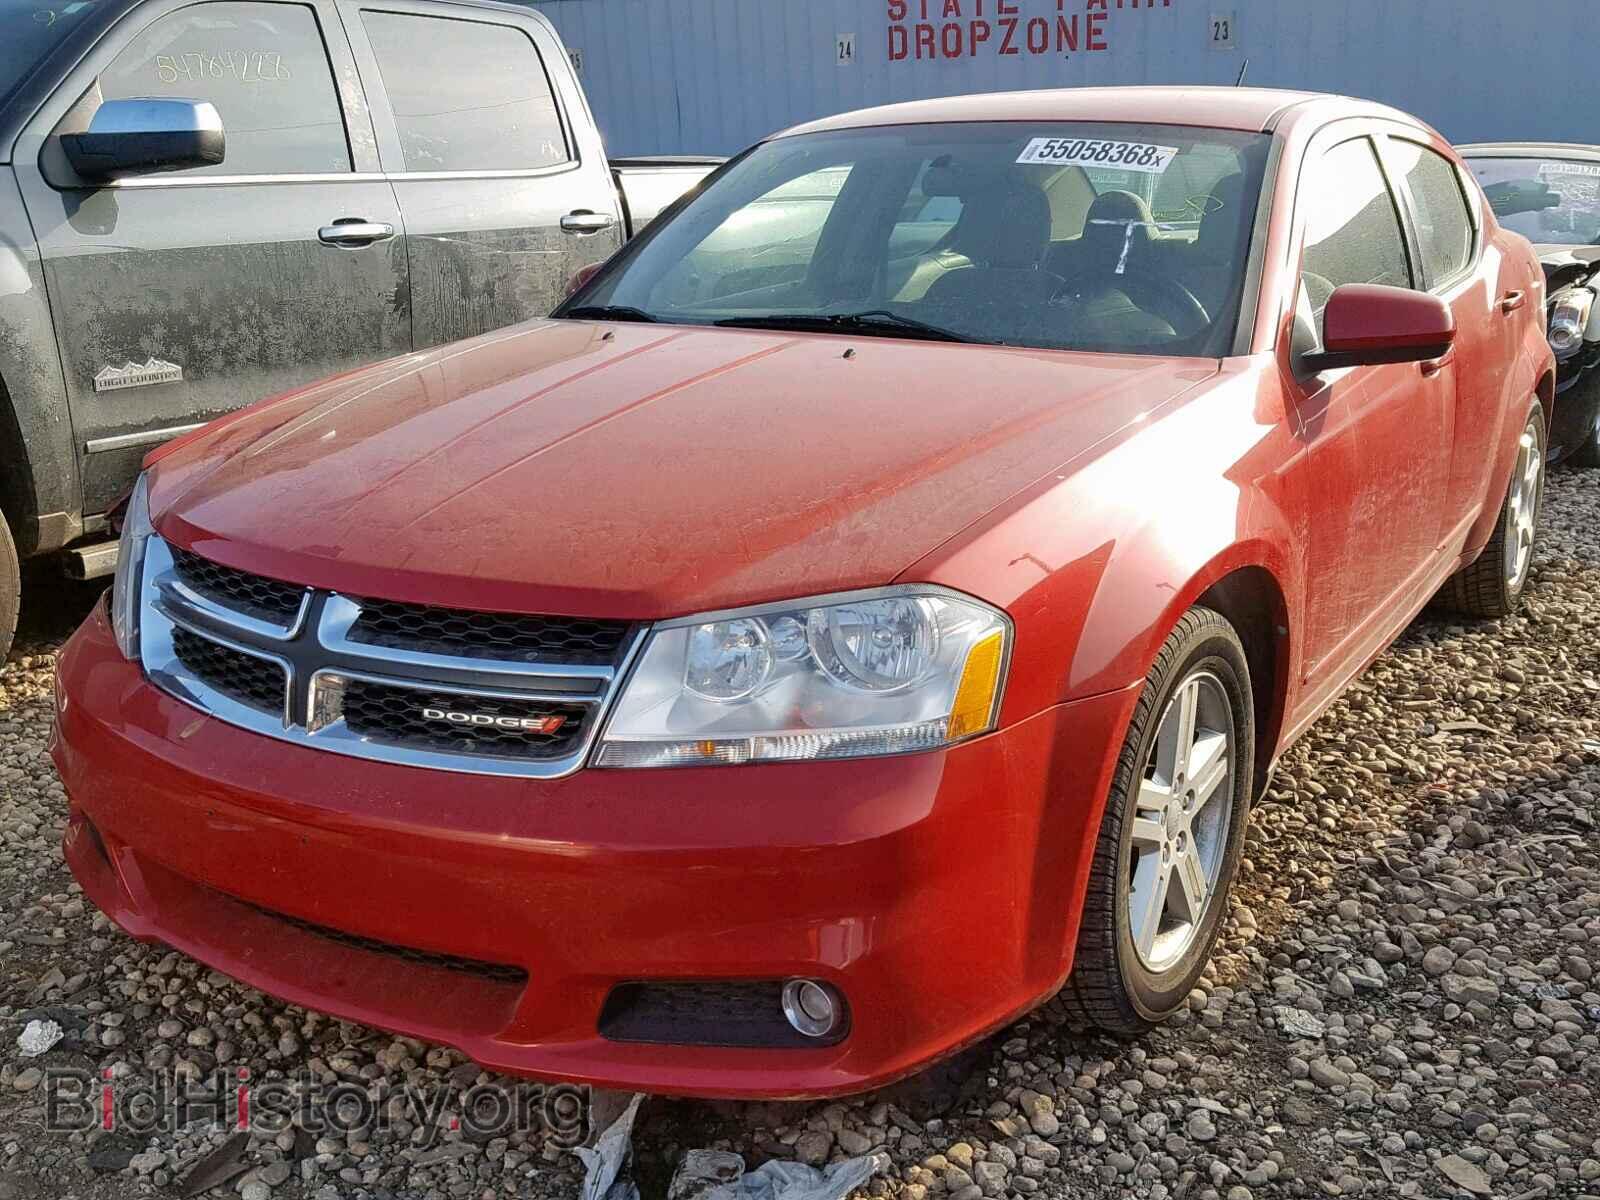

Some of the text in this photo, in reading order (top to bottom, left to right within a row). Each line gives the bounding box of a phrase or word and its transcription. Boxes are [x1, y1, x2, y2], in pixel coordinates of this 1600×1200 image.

[888, 13, 1108, 60] DROPZONE
[1214, 20, 1229, 40] 23
[839, 41, 851, 59] 24
[99, 371, 177, 387] HIGH COUNTRY
[423, 708, 543, 730] DODGE
